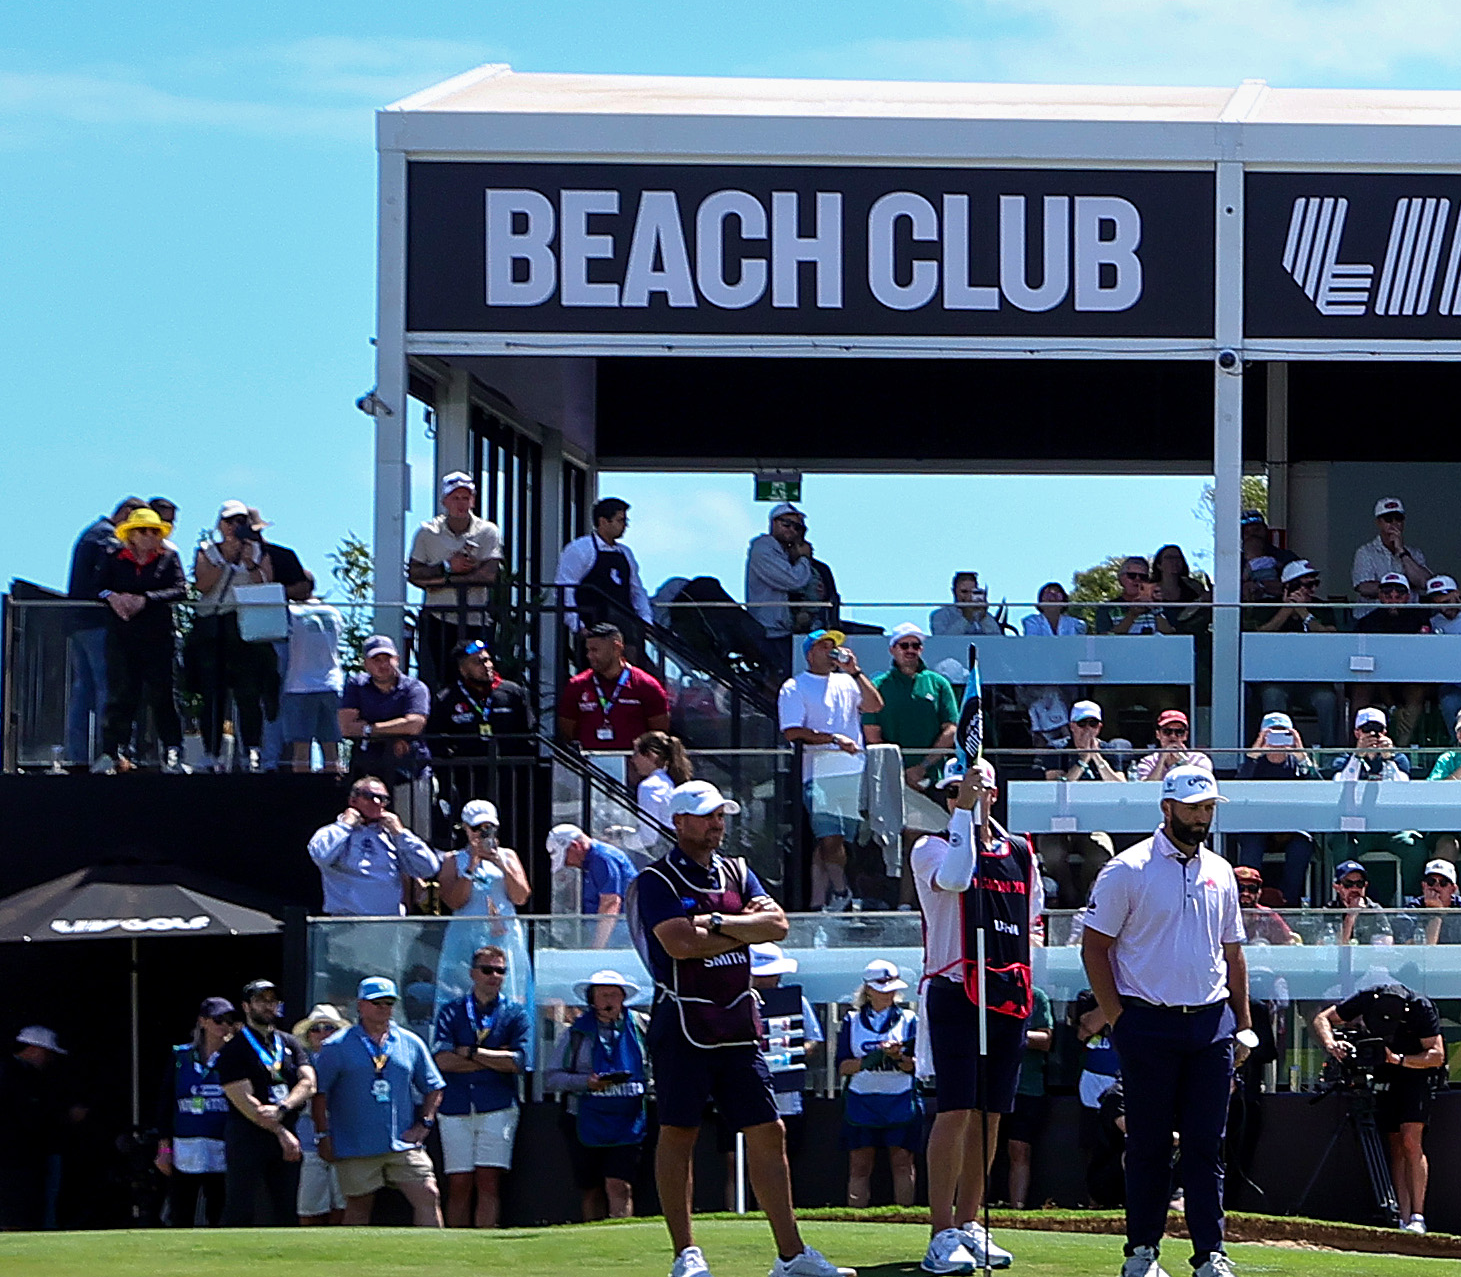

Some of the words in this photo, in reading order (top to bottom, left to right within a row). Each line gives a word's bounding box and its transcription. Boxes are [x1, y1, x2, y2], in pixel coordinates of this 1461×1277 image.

[485, 188, 843, 308] BEACH
[868, 191, 1142, 312] CLUB
[119, 916, 210, 932] GOLF
[704, 952, 747, 968] SMITH
